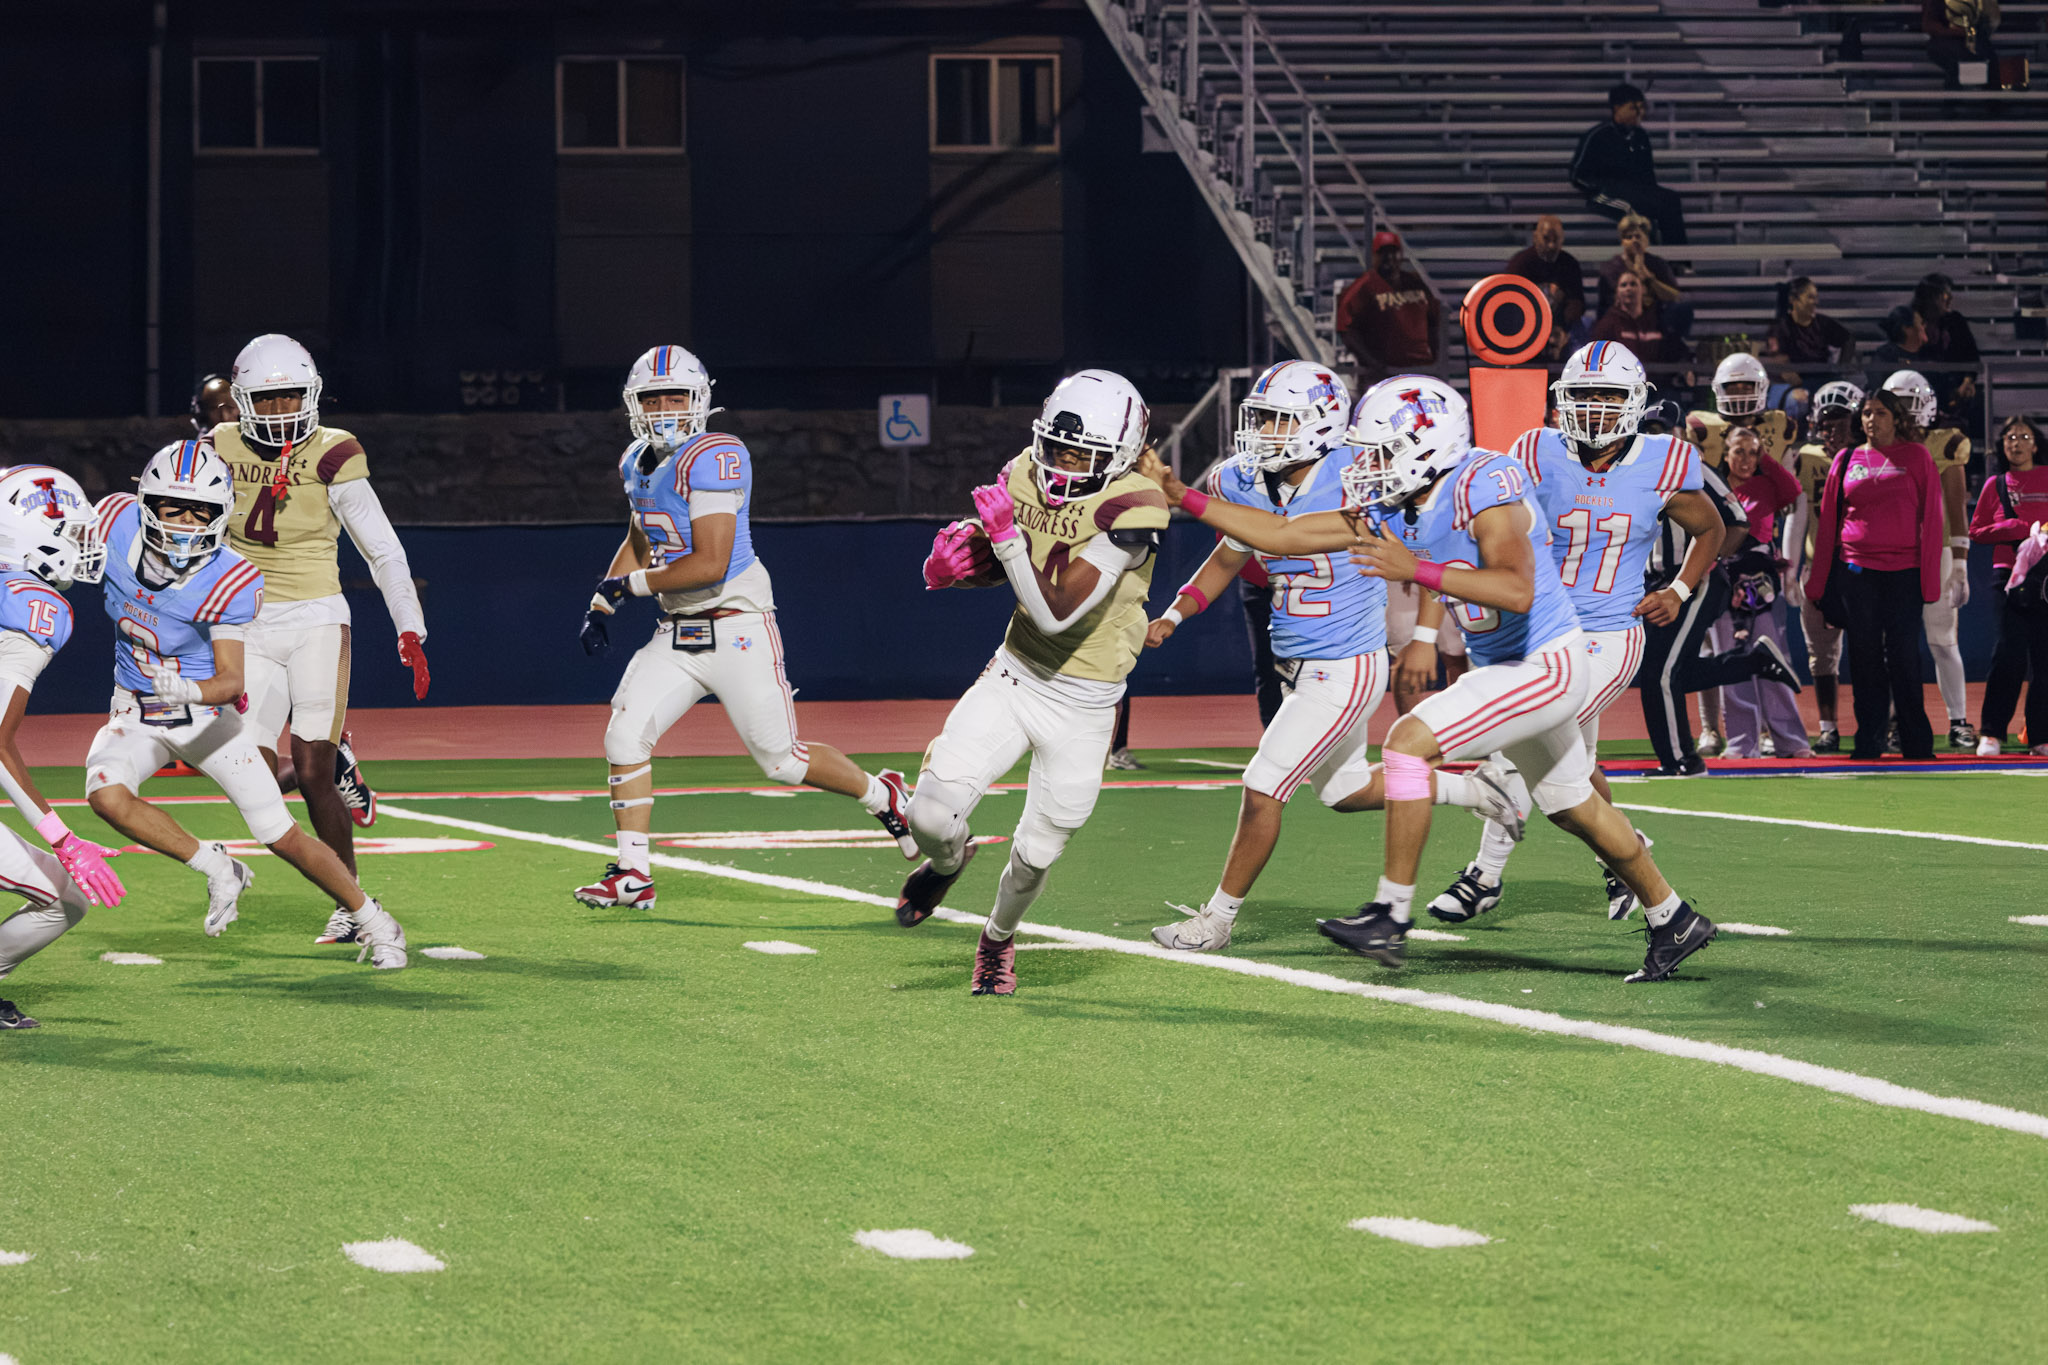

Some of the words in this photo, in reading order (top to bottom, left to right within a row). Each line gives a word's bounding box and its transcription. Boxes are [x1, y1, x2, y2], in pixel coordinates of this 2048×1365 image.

[714, 451, 741, 480] 12
[1488, 466, 1523, 502] 30
[1574, 494, 1614, 508] ROCKETS
[244, 485, 279, 548] 4
[1018, 502, 1079, 539] ANDRESS
[1557, 508, 1632, 594] 11
[28, 599, 58, 637] 15
[123, 601, 159, 627] ROCKETS
